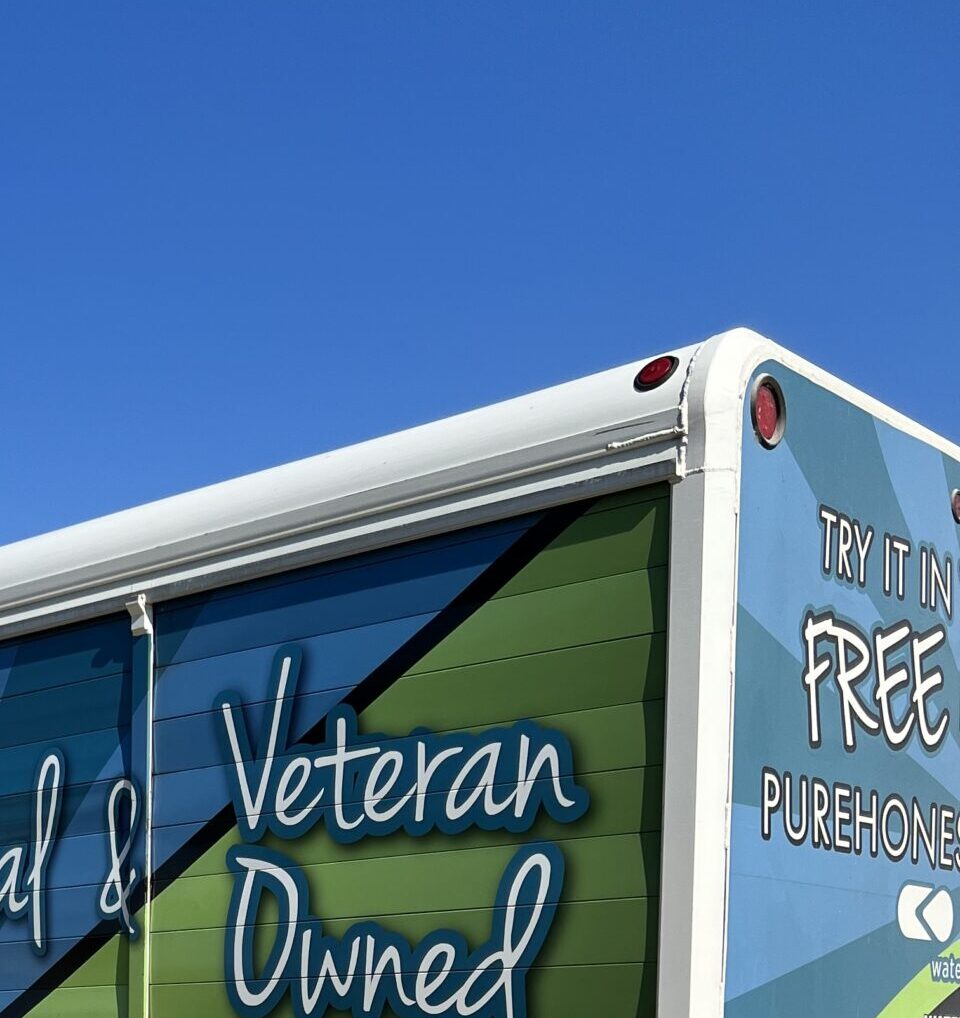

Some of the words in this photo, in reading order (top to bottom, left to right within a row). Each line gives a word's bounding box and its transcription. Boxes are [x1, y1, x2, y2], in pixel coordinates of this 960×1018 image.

[820, 510, 872, 583] TRY
[884, 538, 909, 596] IT
[921, 551, 951, 616] IN
[222, 656, 576, 831] Veteran
[805, 617, 948, 746] FREE
[100, 779, 139, 935] &
